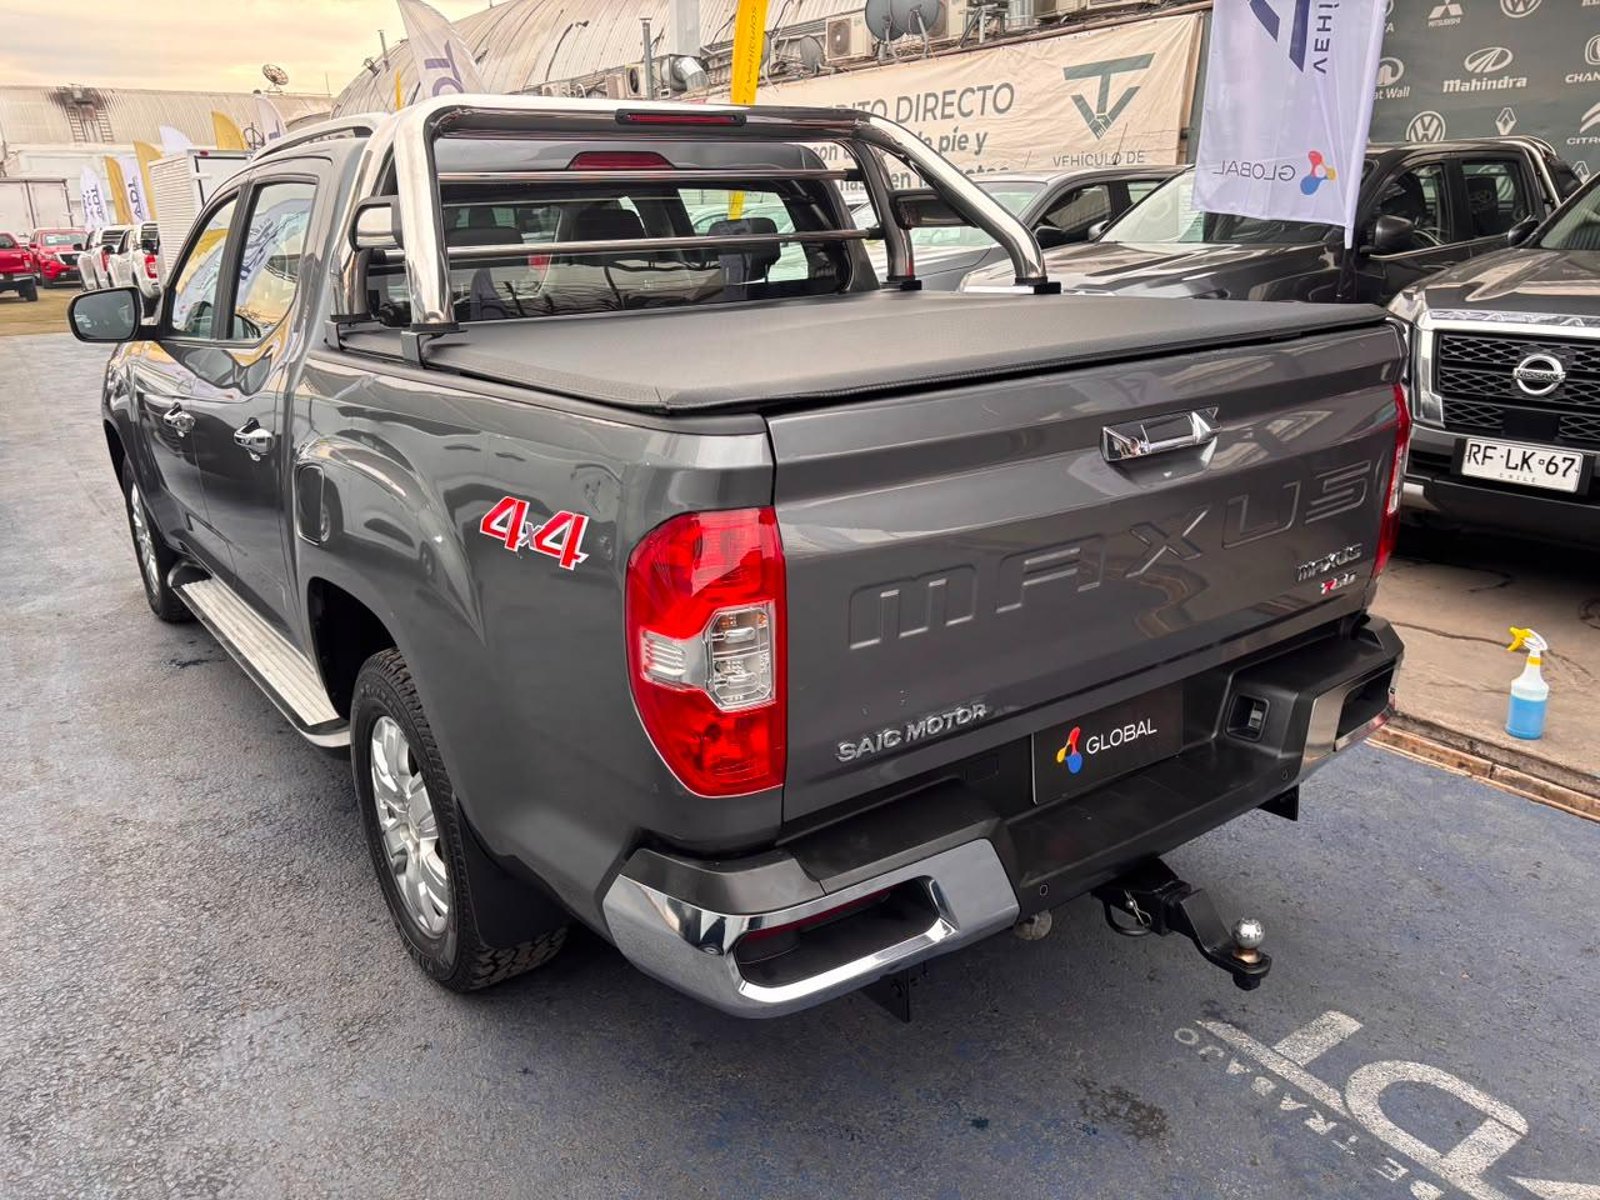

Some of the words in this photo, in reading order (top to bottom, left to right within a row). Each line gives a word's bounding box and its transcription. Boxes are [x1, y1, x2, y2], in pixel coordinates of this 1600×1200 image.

[896, 82, 1015, 124] DIRECTO
[1386, 86, 1411, 99] Wall
[1443, 76, 1528, 93] Mahindra
[973, 132, 988, 156] y
[480, 495, 589, 571] 4x4
[837, 727, 902, 764] SAIC
[904, 701, 989, 743] MOTOR
[1086, 717, 1158, 757] GLOBAL
